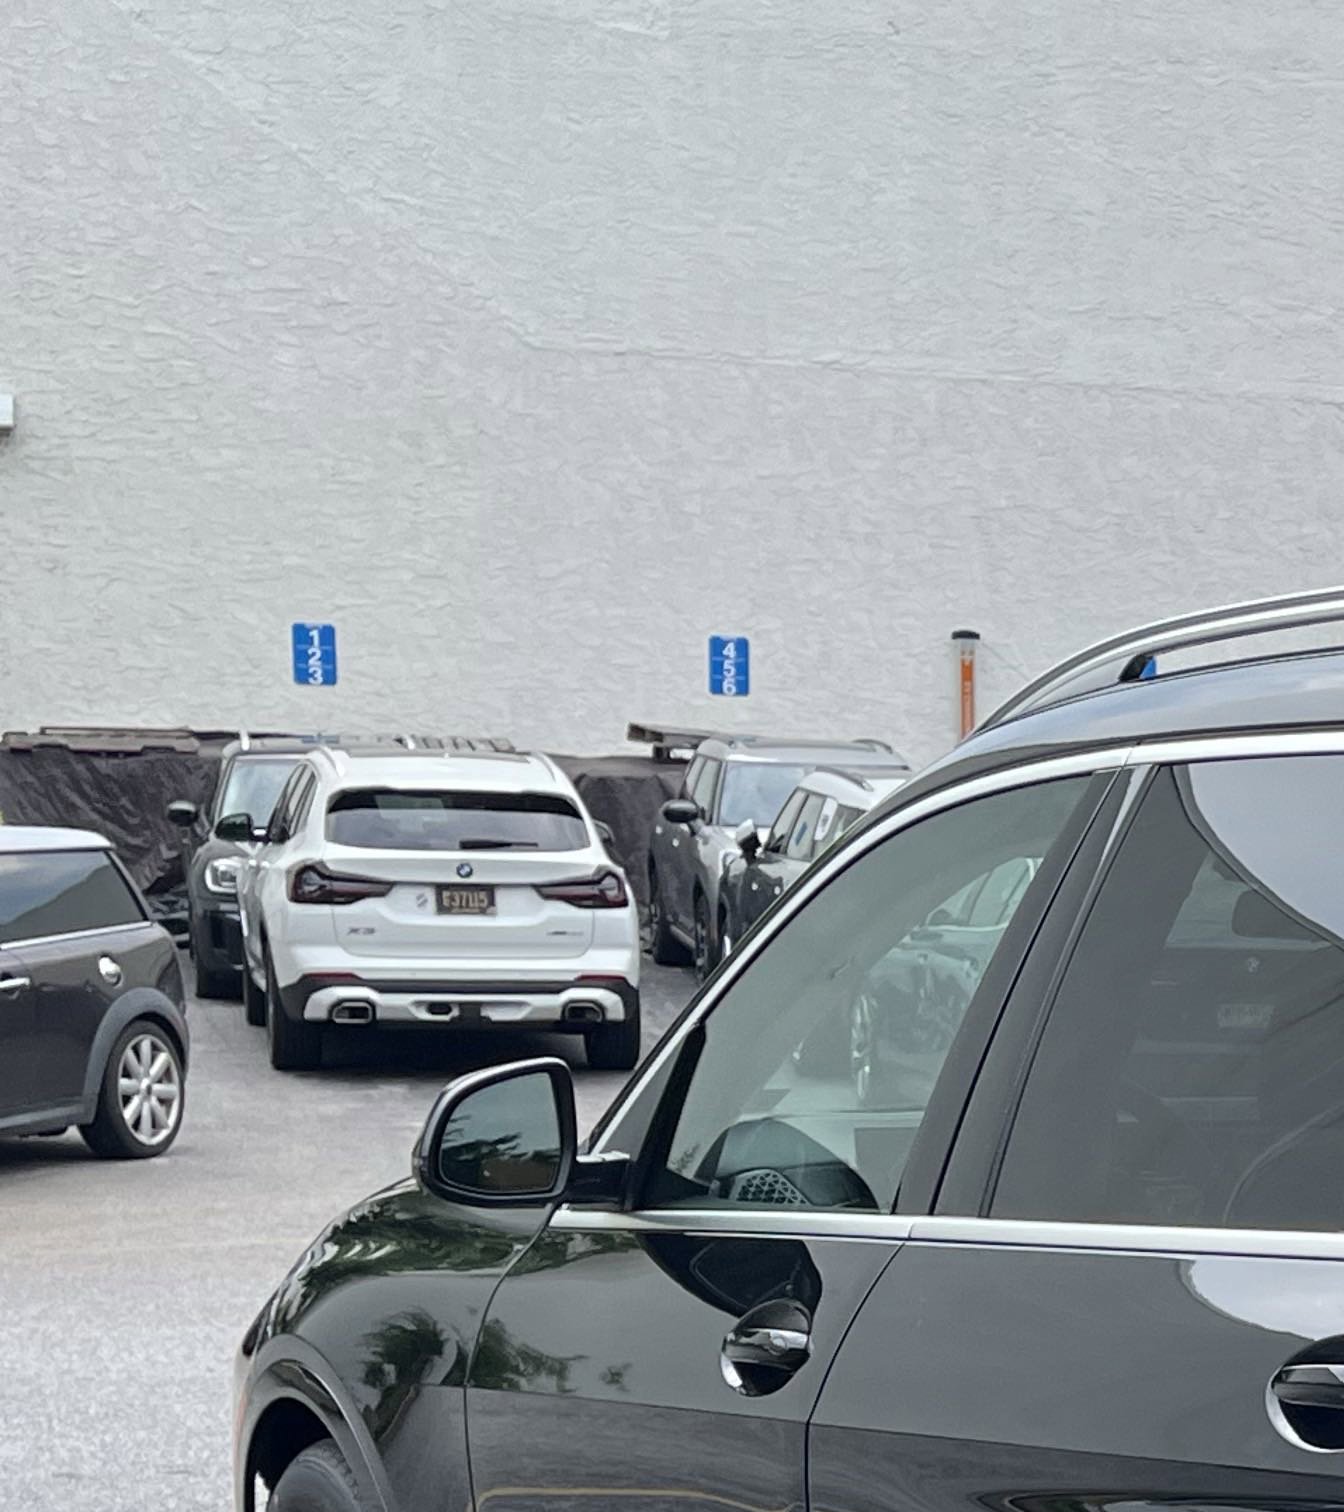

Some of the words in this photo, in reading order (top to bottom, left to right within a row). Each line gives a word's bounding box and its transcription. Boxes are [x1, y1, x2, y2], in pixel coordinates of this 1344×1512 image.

[308, 629, 320, 648] 1
[307, 647, 322, 665] 2
[722, 642, 736, 658] 4
[308, 666, 323, 685] 3
[723, 659, 735, 677] 5
[722, 678, 736, 695] 6
